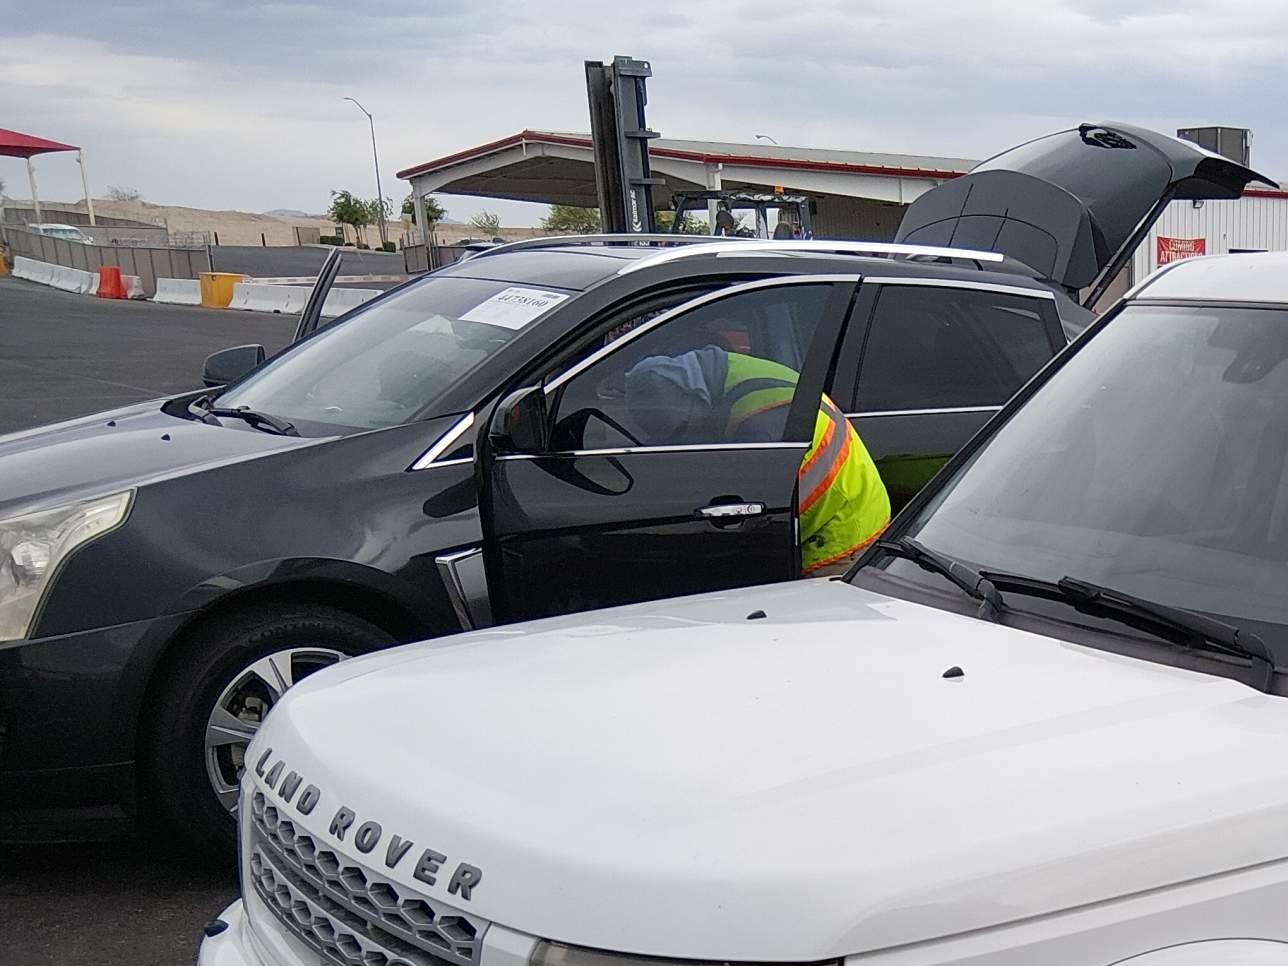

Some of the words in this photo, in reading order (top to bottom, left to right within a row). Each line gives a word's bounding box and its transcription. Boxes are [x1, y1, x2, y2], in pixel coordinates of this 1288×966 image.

[1168, 239, 1195, 251] COMING
[255, 748, 321, 816] LAND
[328, 806, 483, 901] ROVER
